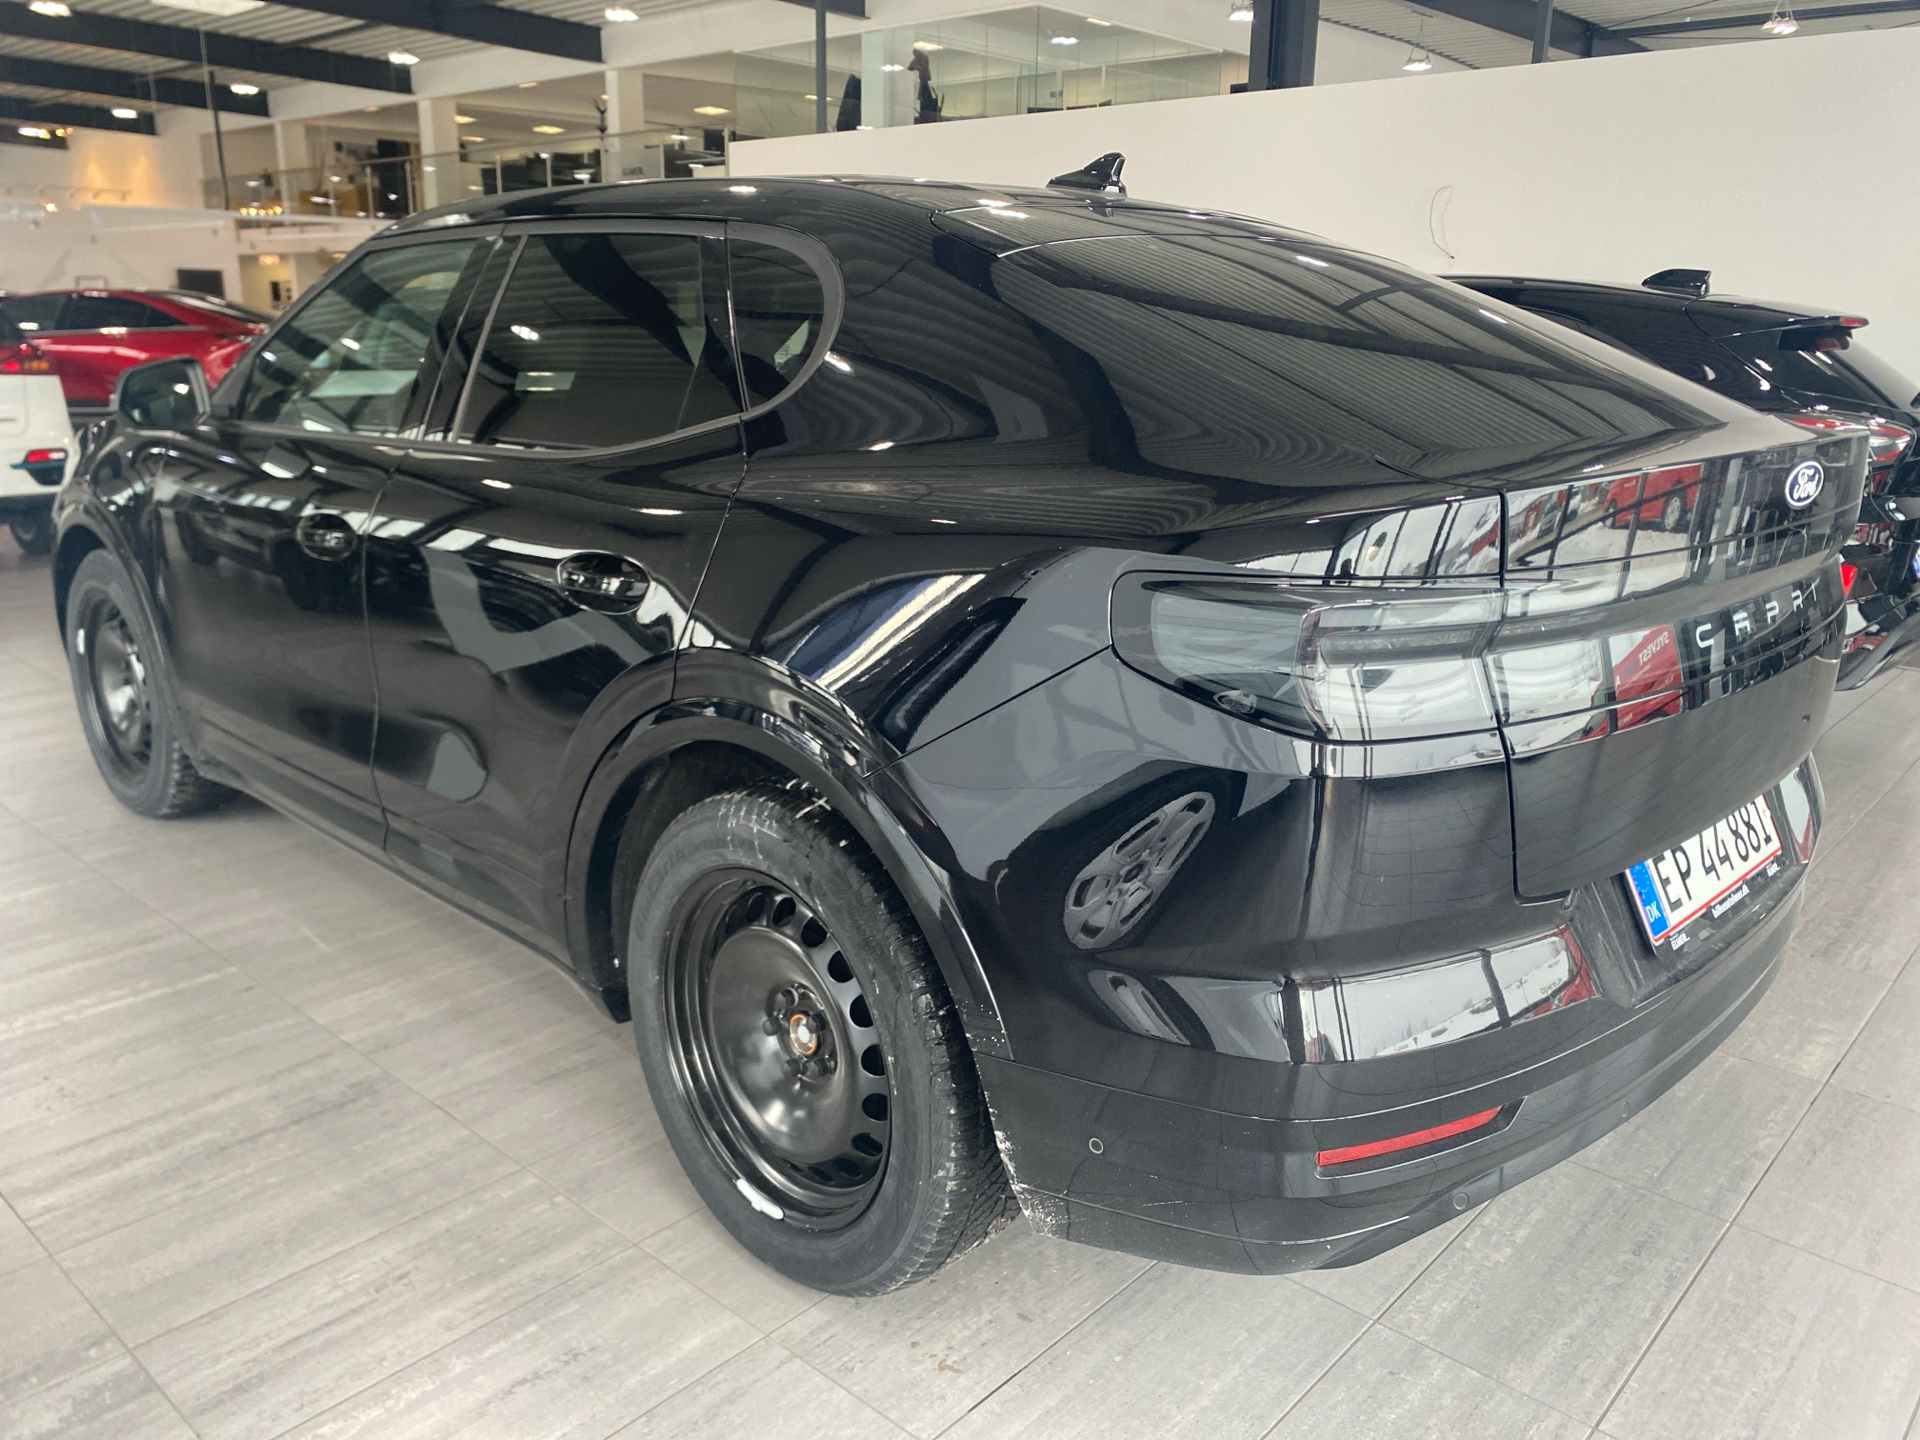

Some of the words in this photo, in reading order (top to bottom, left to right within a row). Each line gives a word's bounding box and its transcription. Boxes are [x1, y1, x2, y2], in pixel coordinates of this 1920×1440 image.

[1791, 466, 1820, 502] Ford
[1696, 582, 1818, 648] CAPRI
[1652, 844, 1692, 913] EP
[1645, 900, 1662, 923] DK
